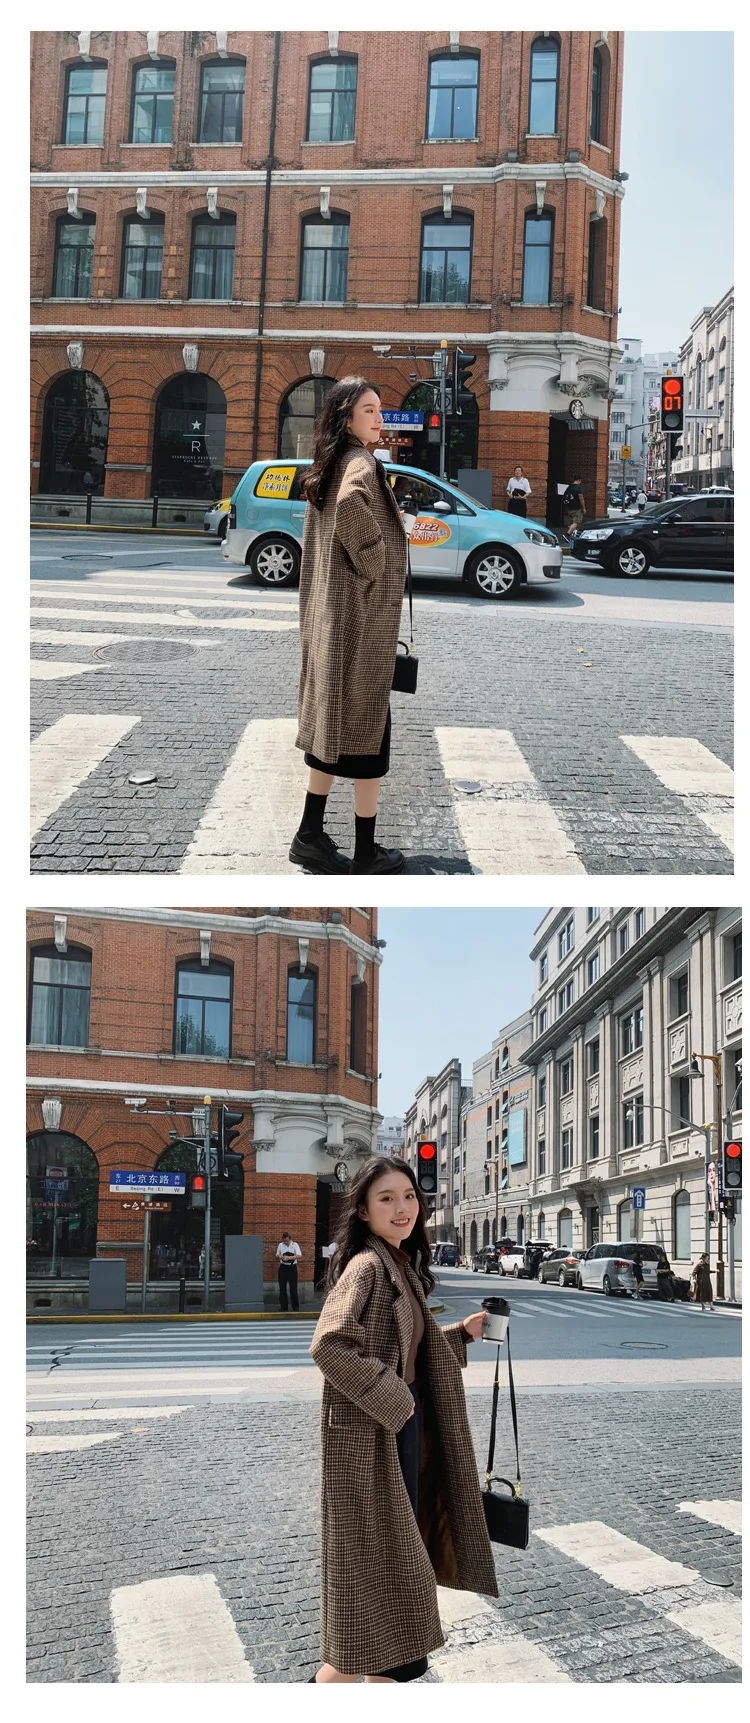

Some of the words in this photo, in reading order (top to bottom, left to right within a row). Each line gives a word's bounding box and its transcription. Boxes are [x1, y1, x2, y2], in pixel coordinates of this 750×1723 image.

[664, 396, 681, 411] 07
[192, 441, 201, 452] R
[126, 1174, 169, 1184] 北京东路
